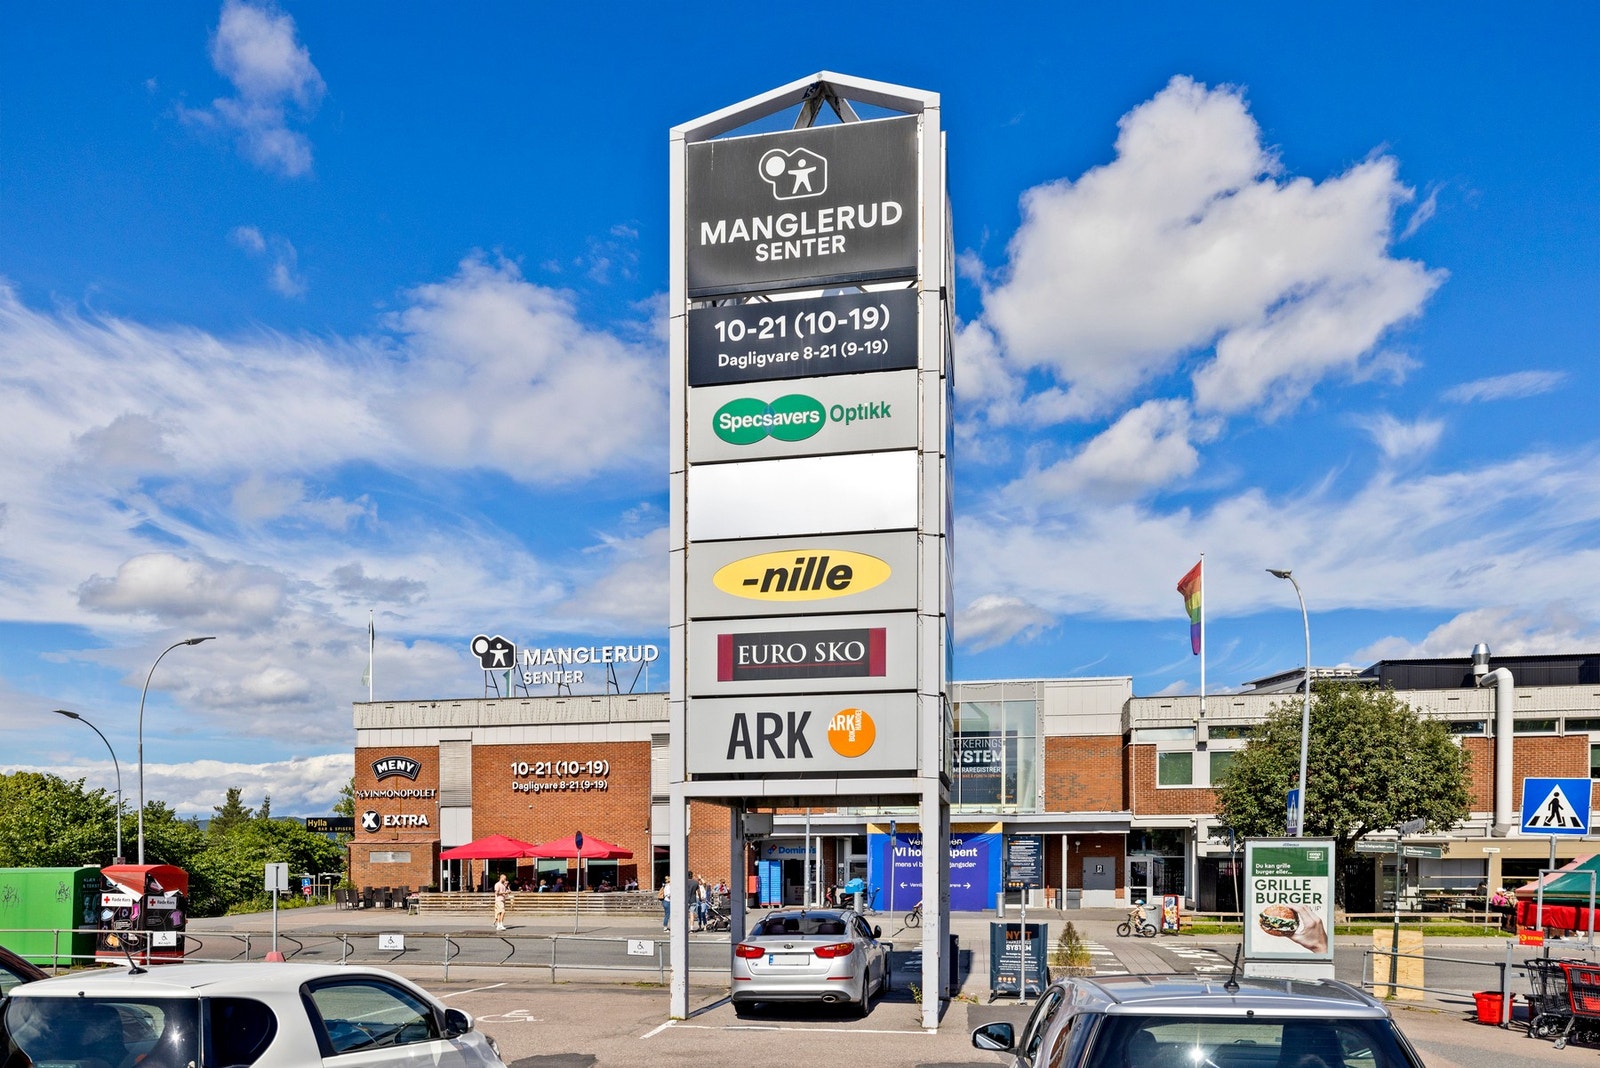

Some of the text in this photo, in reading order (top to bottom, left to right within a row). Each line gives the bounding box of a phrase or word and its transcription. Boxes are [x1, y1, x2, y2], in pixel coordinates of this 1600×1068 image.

[701, 201, 903, 246] MANGLERUD
[755, 234, 846, 262] SENTER
[714, 303, 890, 343] 10-21 (10-19)
[718, 338, 889, 369] Dagligvare 8-21 (9-19)
[719, 401, 892, 433] Specsavers Optikk
[523, 644, 660, 667] MANGLERUD
[737, 641, 866, 666] EURO SKO
[523, 670, 585, 685] SENTER
[828, 714, 855, 731] ARK
[726, 710, 814, 761] ARK
[952, 749, 1003, 763] YSTEM
[376, 760, 415, 774] MENY
[511, 759, 610, 777] 10-21 (10-19)
[364, 788, 436, 798] VINMONOPOLET
[512, 780, 608, 792] Dagligvare 8-21 (9-19)
[307, 818, 328, 828] Hylla
[383, 813, 429, 827] EXTRA
[778, 845, 817, 855] Domin's
[894, 847, 907, 857] Vi
[1276, 862, 1291, 870] grille
[1254, 879, 1312, 891] GRILLE
[1255, 892, 1323, 905] BURGER
[1005, 931, 1032, 941] NYT
